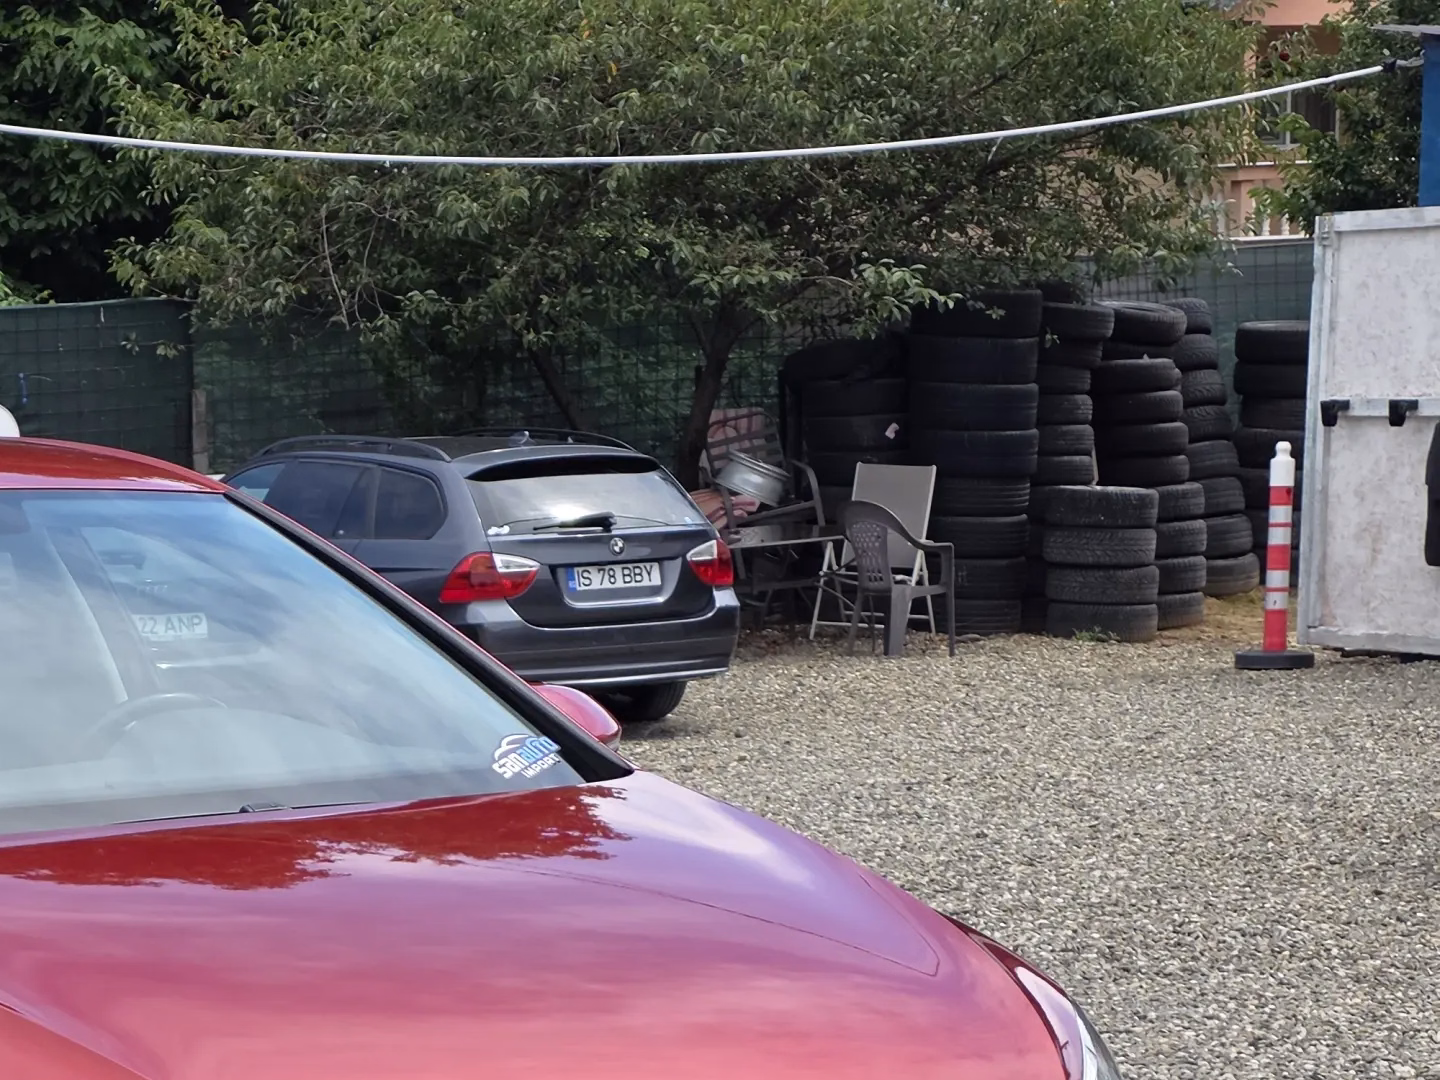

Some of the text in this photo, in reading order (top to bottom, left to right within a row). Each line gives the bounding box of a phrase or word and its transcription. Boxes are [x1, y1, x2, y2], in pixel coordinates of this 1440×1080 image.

[576, 565, 654, 587] IS 78 BBY
[165, 614, 203, 633] ANP
